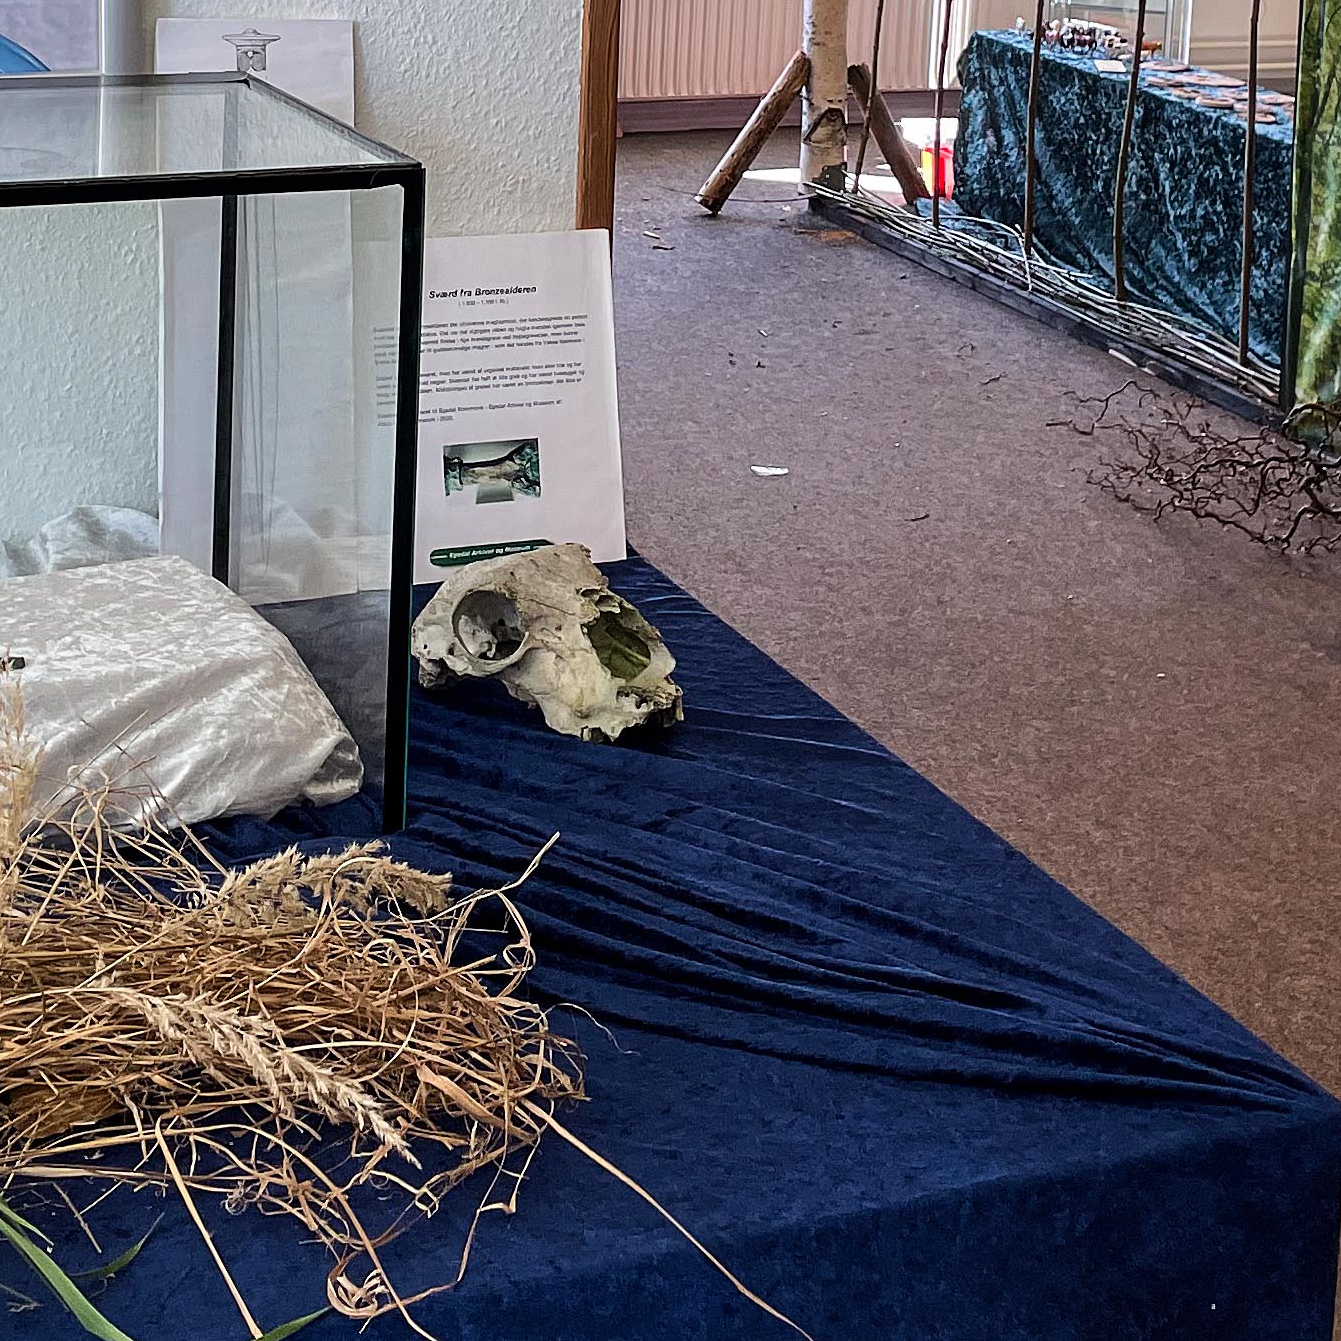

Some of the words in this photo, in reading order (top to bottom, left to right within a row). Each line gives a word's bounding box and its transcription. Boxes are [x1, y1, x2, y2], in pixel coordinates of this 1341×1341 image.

[429, 290, 458, 298] Sværd
[460, 288, 472, 296] fra
[475, 286, 536, 296] Bronzealderen
